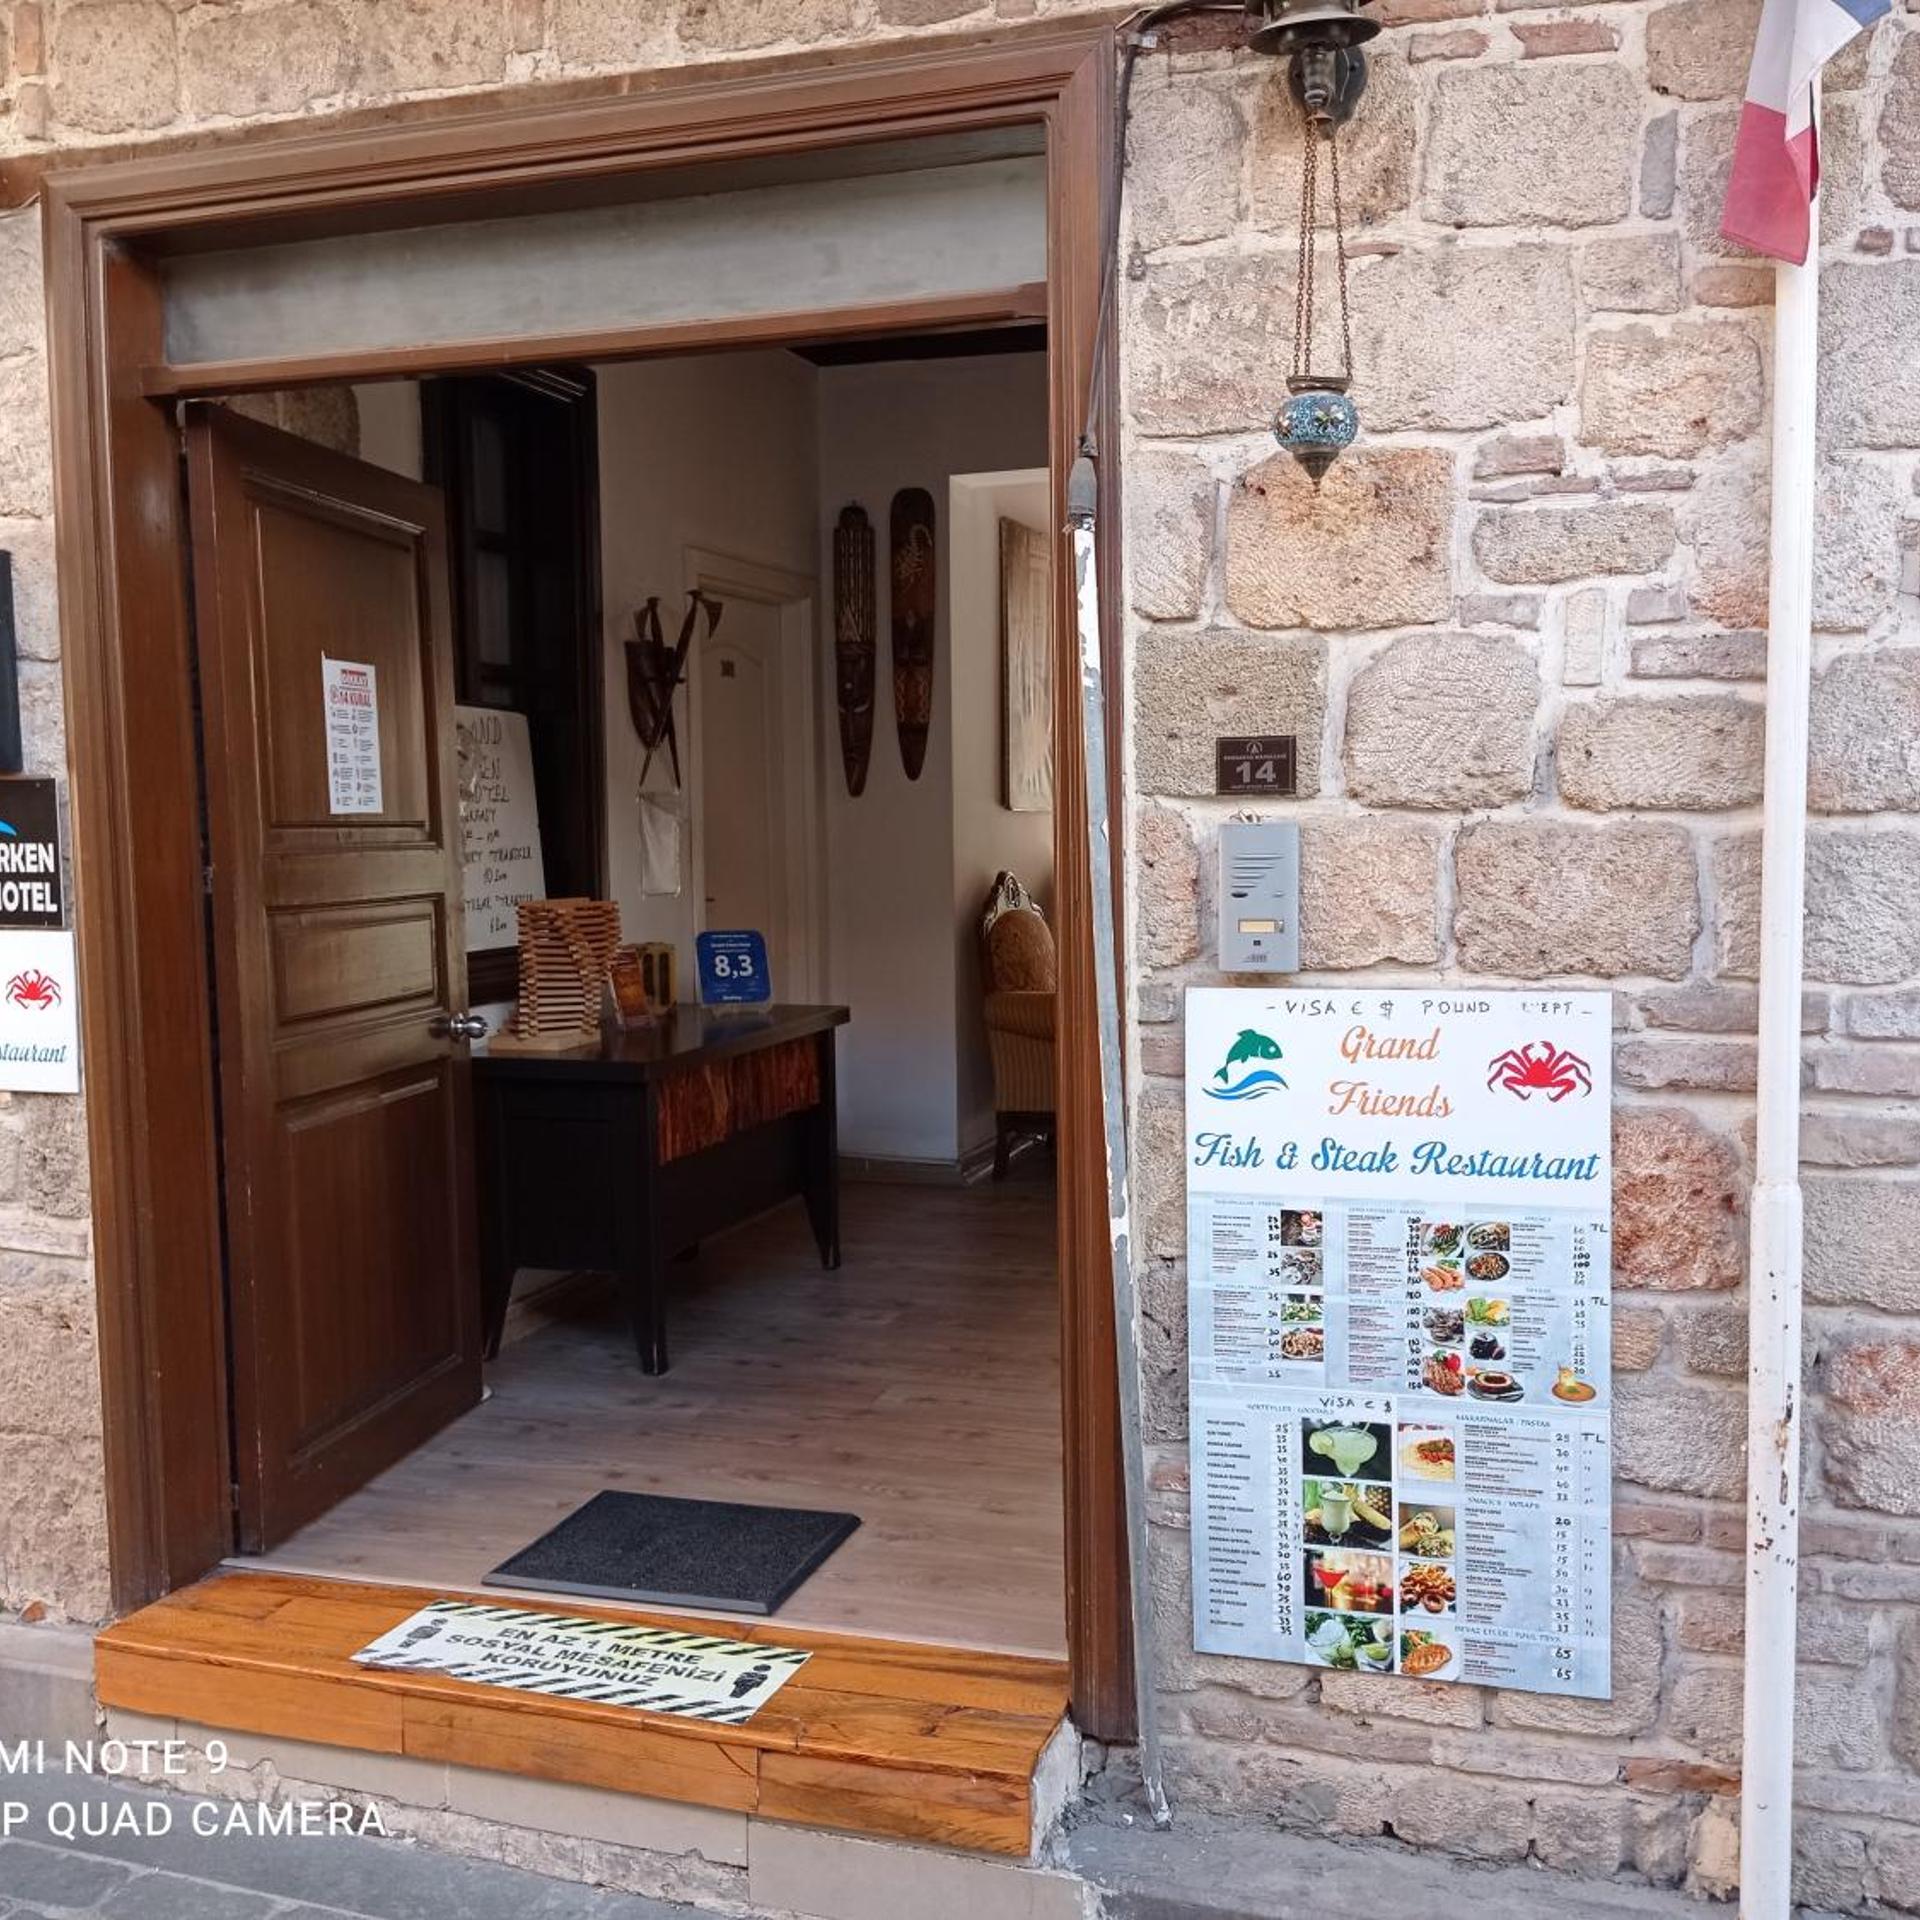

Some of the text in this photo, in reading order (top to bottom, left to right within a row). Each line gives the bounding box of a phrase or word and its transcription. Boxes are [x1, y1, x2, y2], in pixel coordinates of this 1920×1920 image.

[1235, 760, 1277, 783] 14
[0, 881, 58, 913] OTEL
[715, 955, 753, 978] 8,3
[1380, 1000, 1394, 1020] $
[1422, 999, 1490, 1015] POUND
[0, 1043, 67, 1063] taurant
[1340, 1024, 1440, 1064] Grand
[1328, 1080, 1454, 1118] Friends
[1194, 1132, 1601, 1181] Fish & Steak Restaurant
[1590, 1223, 1608, 1232] TL
[1591, 1296, 1609, 1306] TL
[1555, 1517, 1571, 1526] 20
[1556, 1543, 1567, 1552] 15
[1277, 1573, 1291, 1582] 60
[500, 1627, 536, 1642] EN
[545, 1632, 582, 1647] AZ
[607, 1639, 705, 1666] METRE
[1555, 1648, 1572, 1660] 65
[445, 1634, 728, 1683] SOSYAL MESAFENİZİ
[479, 1652, 659, 1688] KORUYUNUZ
[1556, 1667, 1572, 1680] 65
